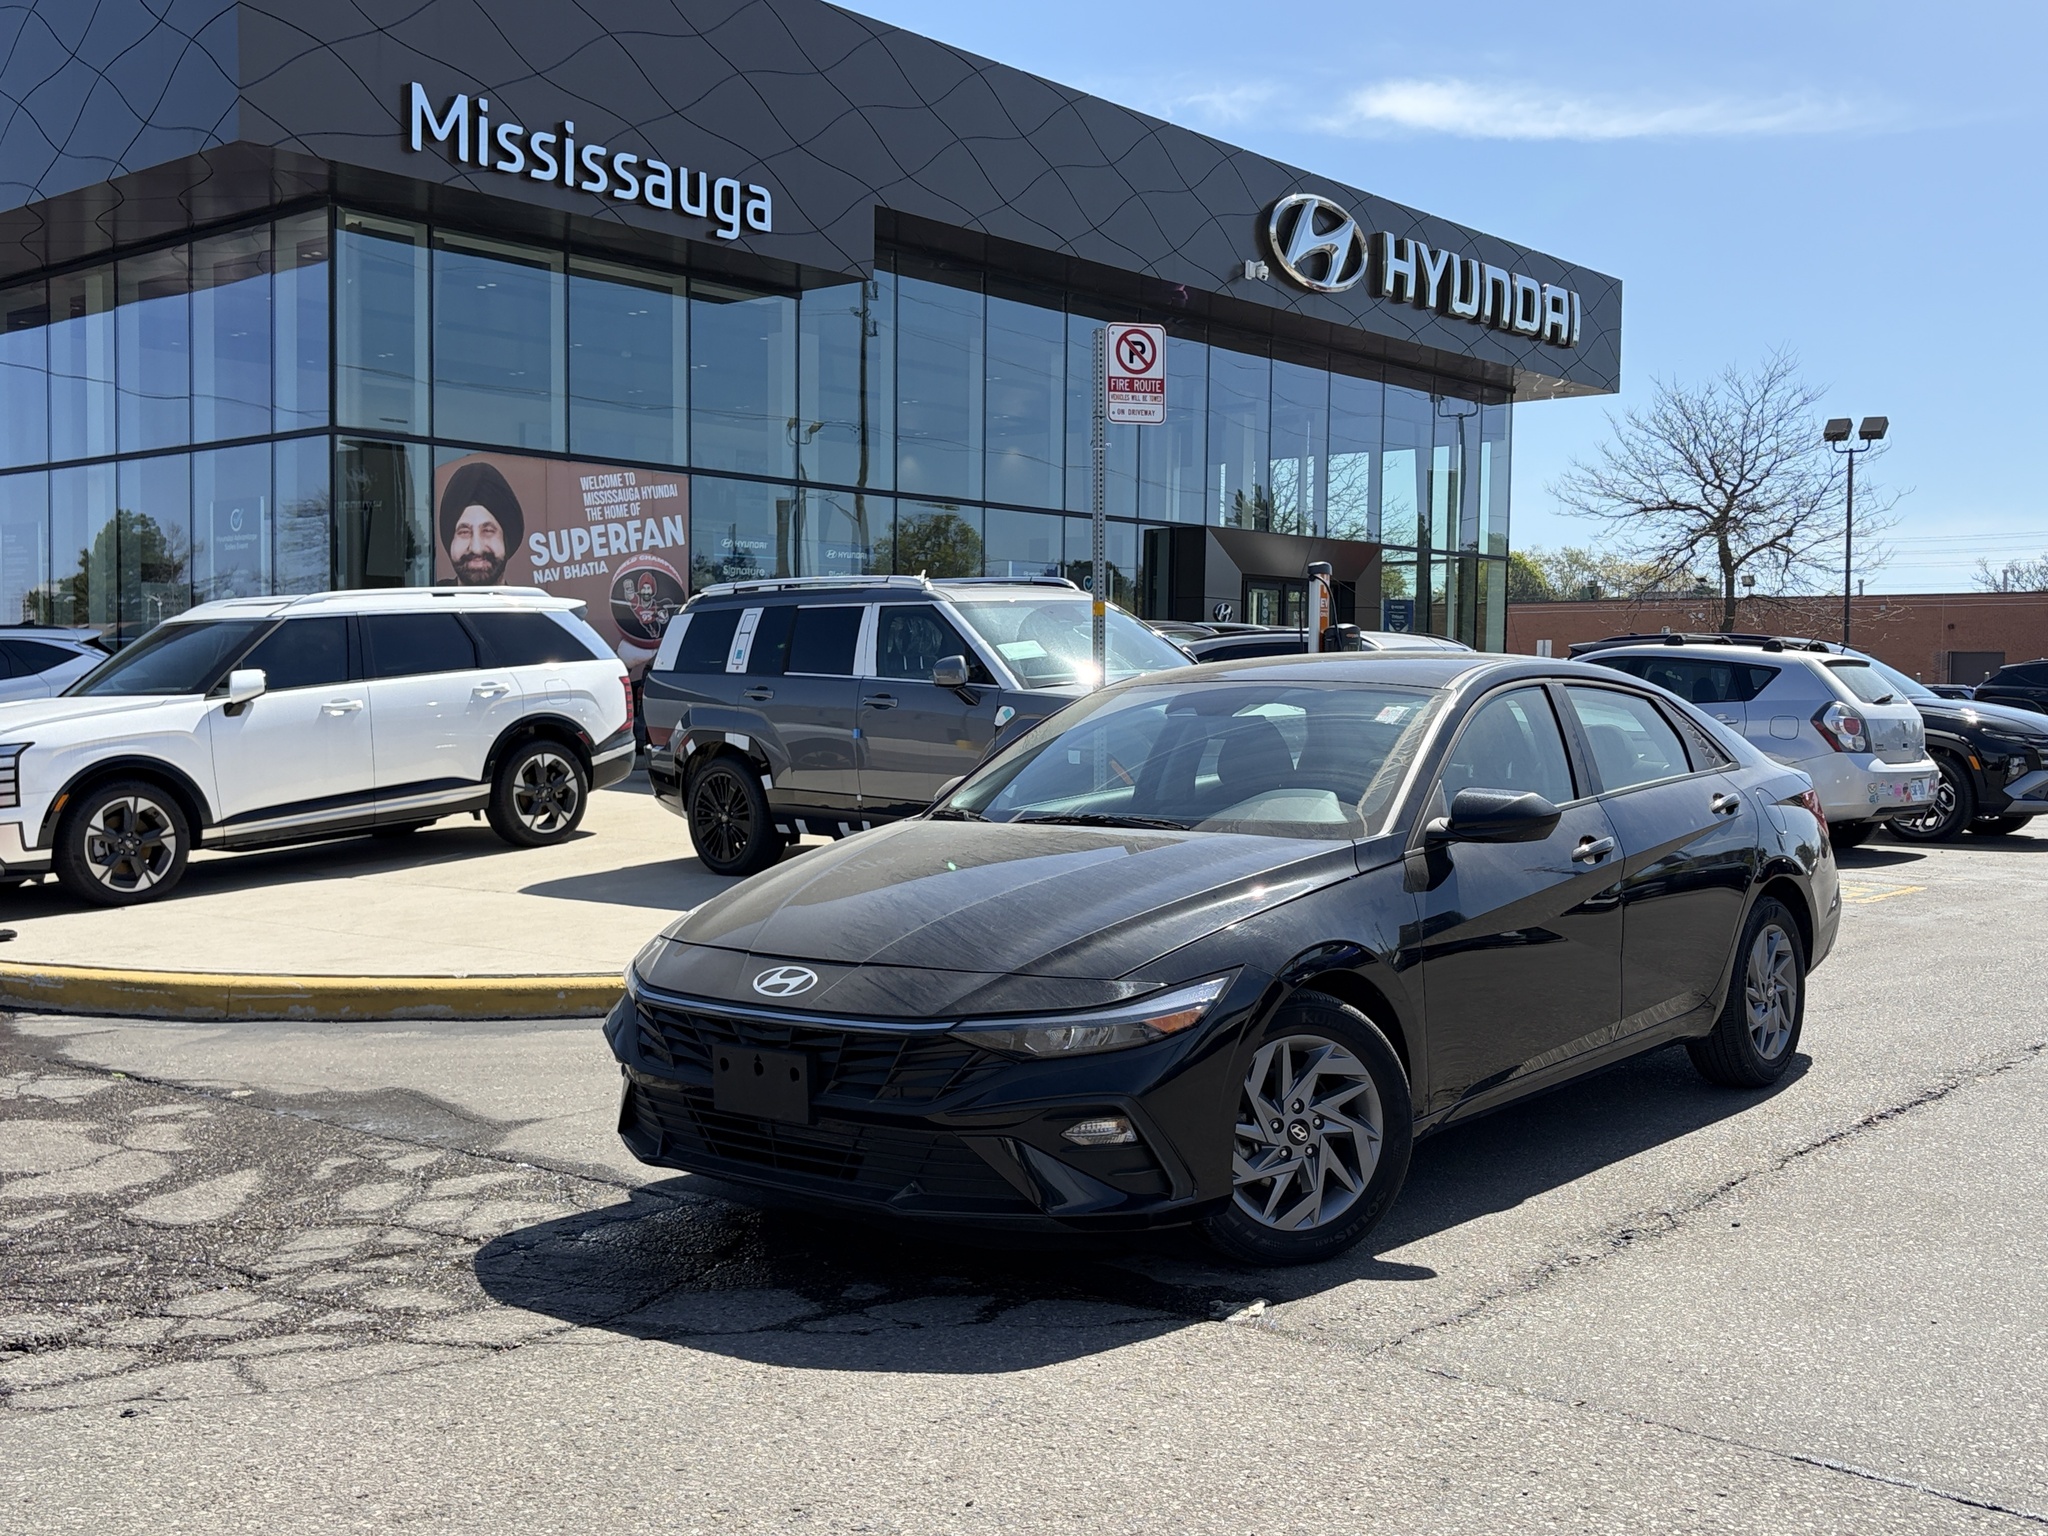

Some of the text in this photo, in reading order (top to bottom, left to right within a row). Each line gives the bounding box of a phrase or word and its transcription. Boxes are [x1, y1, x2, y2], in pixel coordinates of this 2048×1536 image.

[409, 81, 774, 240] Mississauga
[1381, 231, 1581, 348] HYUNDAI
[1110, 378, 1162, 393] FIRE ROUTE
[1110, 393, 1130, 401] VEHICLES
[1131, 394, 1141, 402] WILL
[1127, 408, 1156, 416] DRIVEWAY
[580, 472, 636, 491] WELCOME TO
[583, 484, 678, 506] MISSISSAUGA HYUNDAI
[585, 502, 641, 521] THE HOME OF
[528, 514, 686, 567] SUPERFAN
[734, 540, 769, 549] HYUNDAI
[837, 551, 868, 560] HYUNDAI
[532, 560, 609, 584] NAV BHATIA
[722, 564, 766, 577] Signature
[1334, 1189, 1388, 1244] SOLUS
